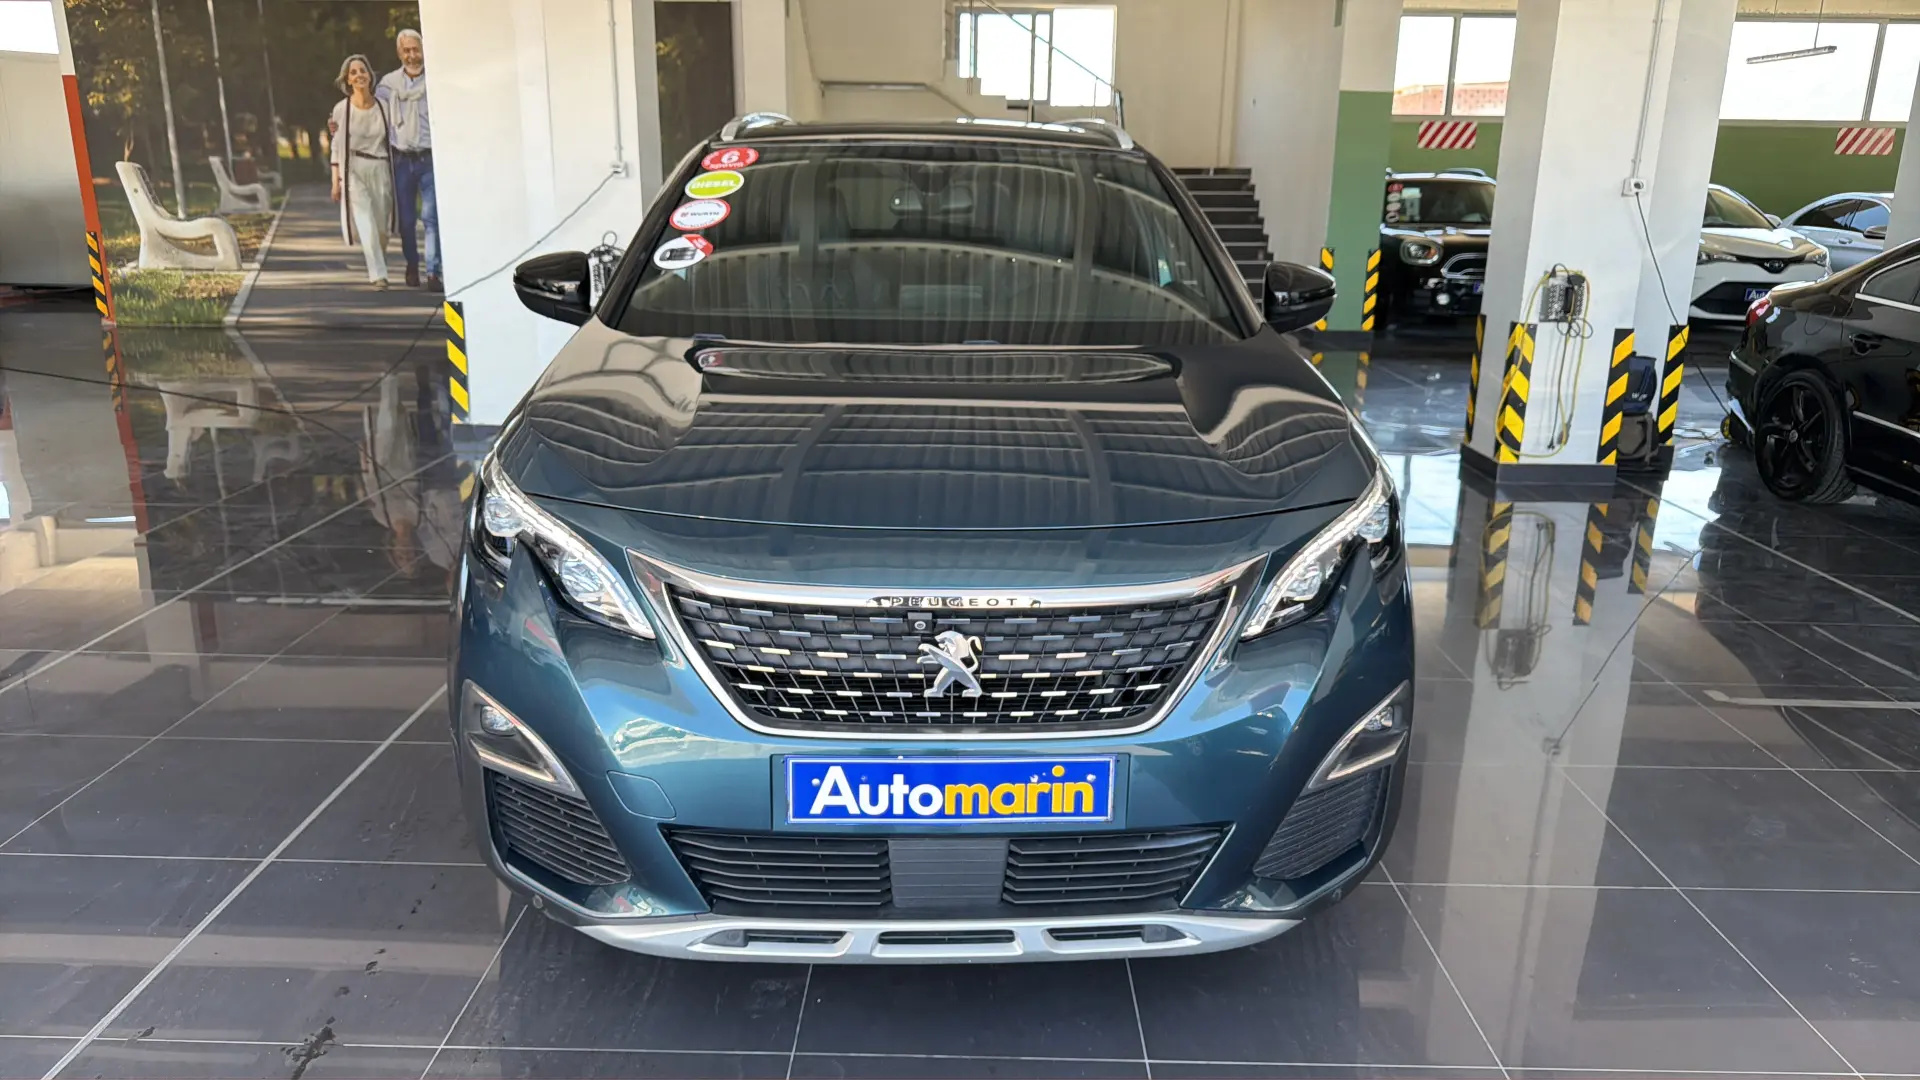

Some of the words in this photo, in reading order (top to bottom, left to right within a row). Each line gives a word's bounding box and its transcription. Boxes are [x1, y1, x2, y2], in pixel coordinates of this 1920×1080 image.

[721, 150, 740, 163] 6
[690, 179, 736, 188] DIESEL
[891, 596, 1018, 606] PEUGEOT
[809, 765, 1094, 815] Automarin
